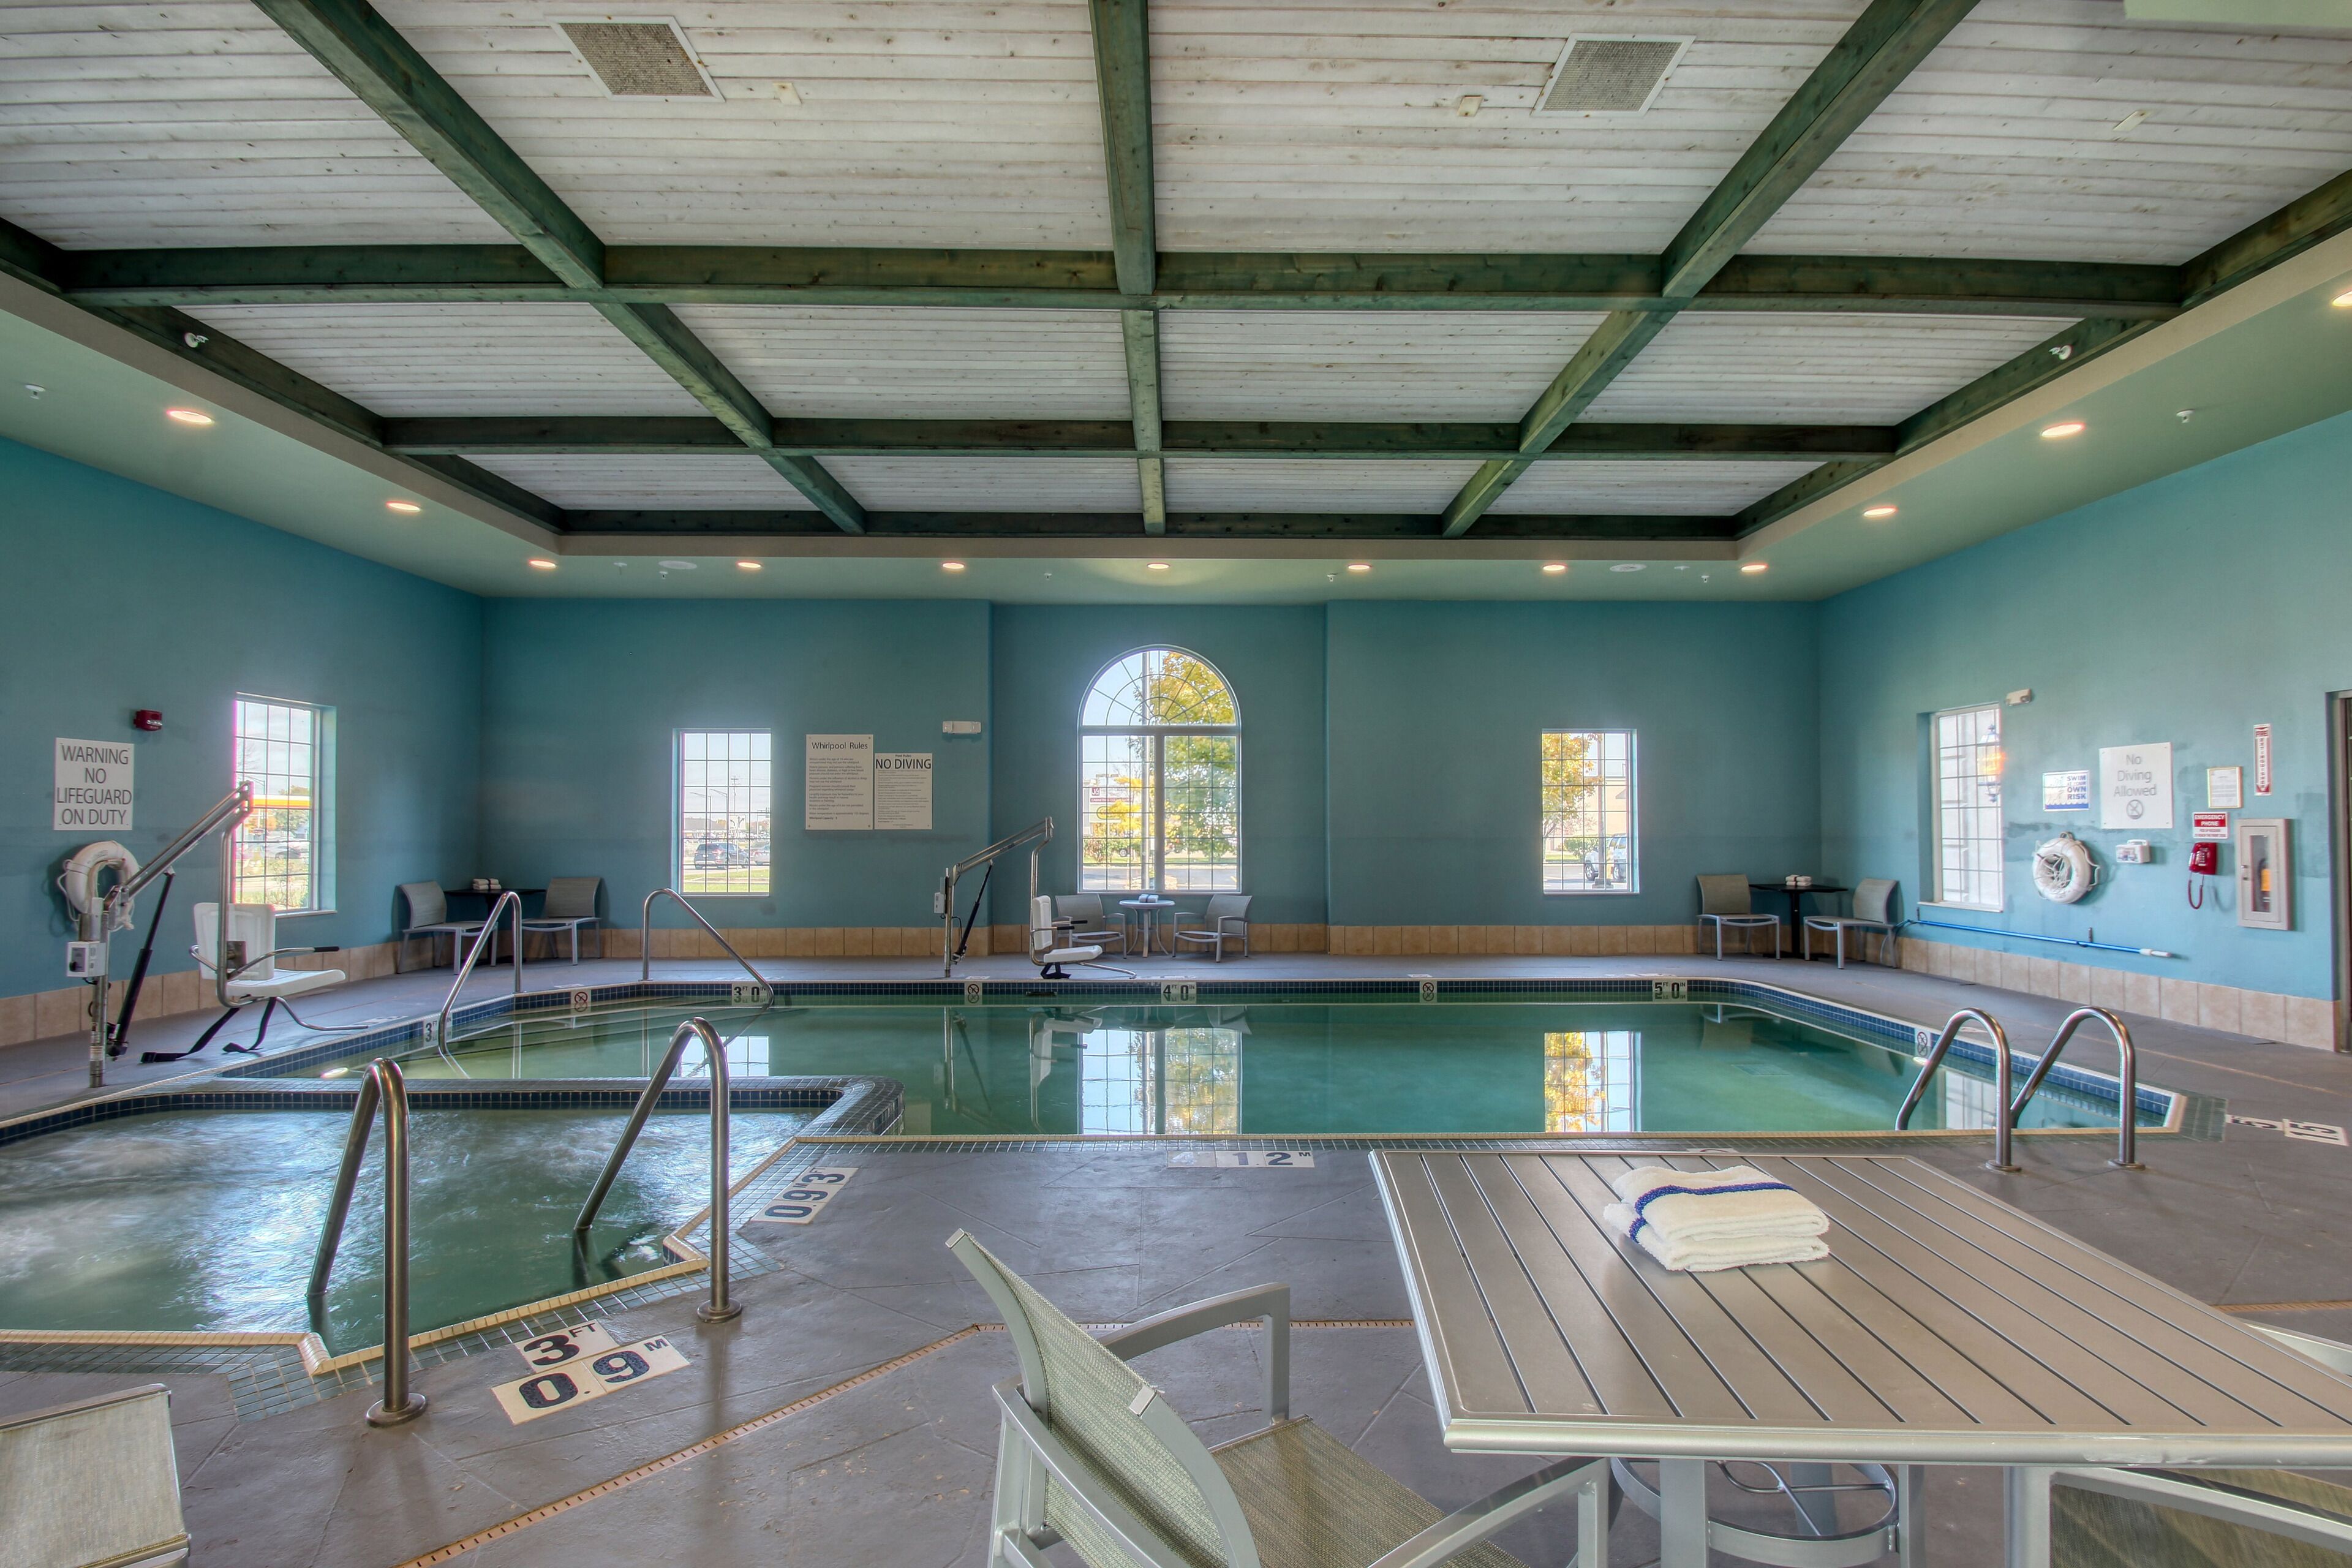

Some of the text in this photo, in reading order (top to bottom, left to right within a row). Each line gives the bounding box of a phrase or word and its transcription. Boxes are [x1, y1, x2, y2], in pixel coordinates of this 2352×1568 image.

[812, 742, 846, 750] Whirlpool
[62, 745, 129, 764] WARNING
[2126, 754, 2142, 765] No
[876, 759, 931, 769] NO DIVING
[85, 767, 107, 783] NO
[2117, 770, 2152, 783] Diving
[56, 787, 132, 805] LIFEGUARD
[2113, 783, 2157, 797] Allowed
[62, 809, 127, 825] ON DUTY
[1163, 985, 1171, 993] 4
[801, 1173, 845, 1183] 3
[524, 1322, 597, 1366] 3 FT
[644, 1337, 668, 1351] M
